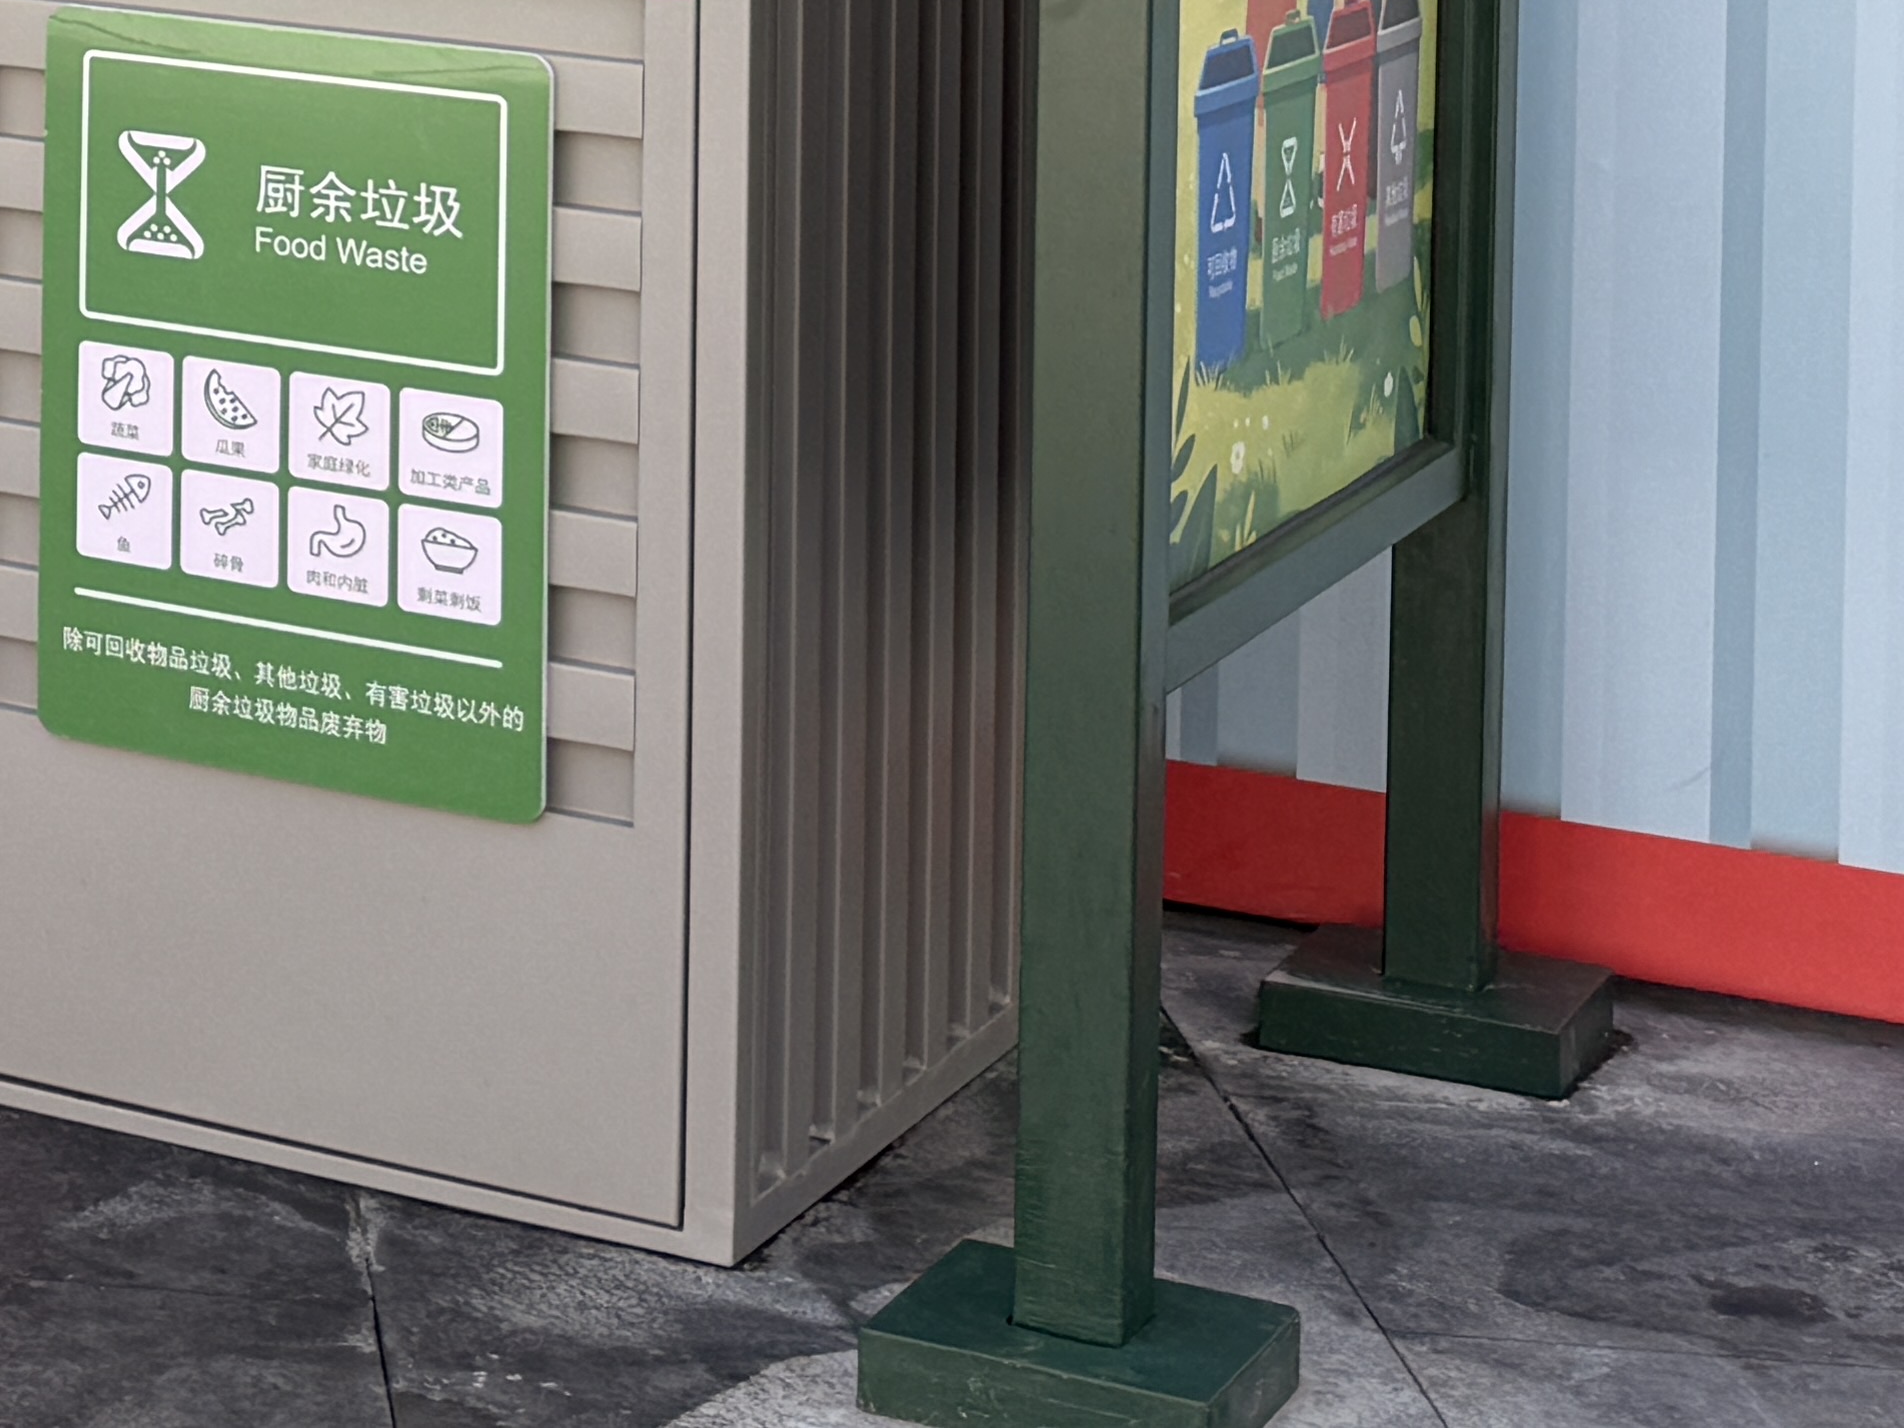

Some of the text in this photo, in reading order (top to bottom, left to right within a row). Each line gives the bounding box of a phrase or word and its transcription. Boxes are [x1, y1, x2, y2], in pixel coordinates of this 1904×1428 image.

[255, 164, 463, 239] 厨余垃圾
[254, 226, 428, 275] Food Waste
[111, 420, 140, 441] 蔬菜
[215, 438, 245, 458] 瓜果
[307, 452, 370, 478] 家庭绿化
[410, 468, 491, 496] 加工类产品
[117, 536, 131, 553] 鱼
[213, 553, 244, 574] 碎骨
[306, 568, 369, 595] 肉和内脏
[417, 586, 482, 613] 剩菜剩饭
[62, 626, 525, 732] 除可回收物品垃圾、其他垃圾、有害垃圾以外的
[189, 685, 387, 745] 厨余垃圾物品废弃物
